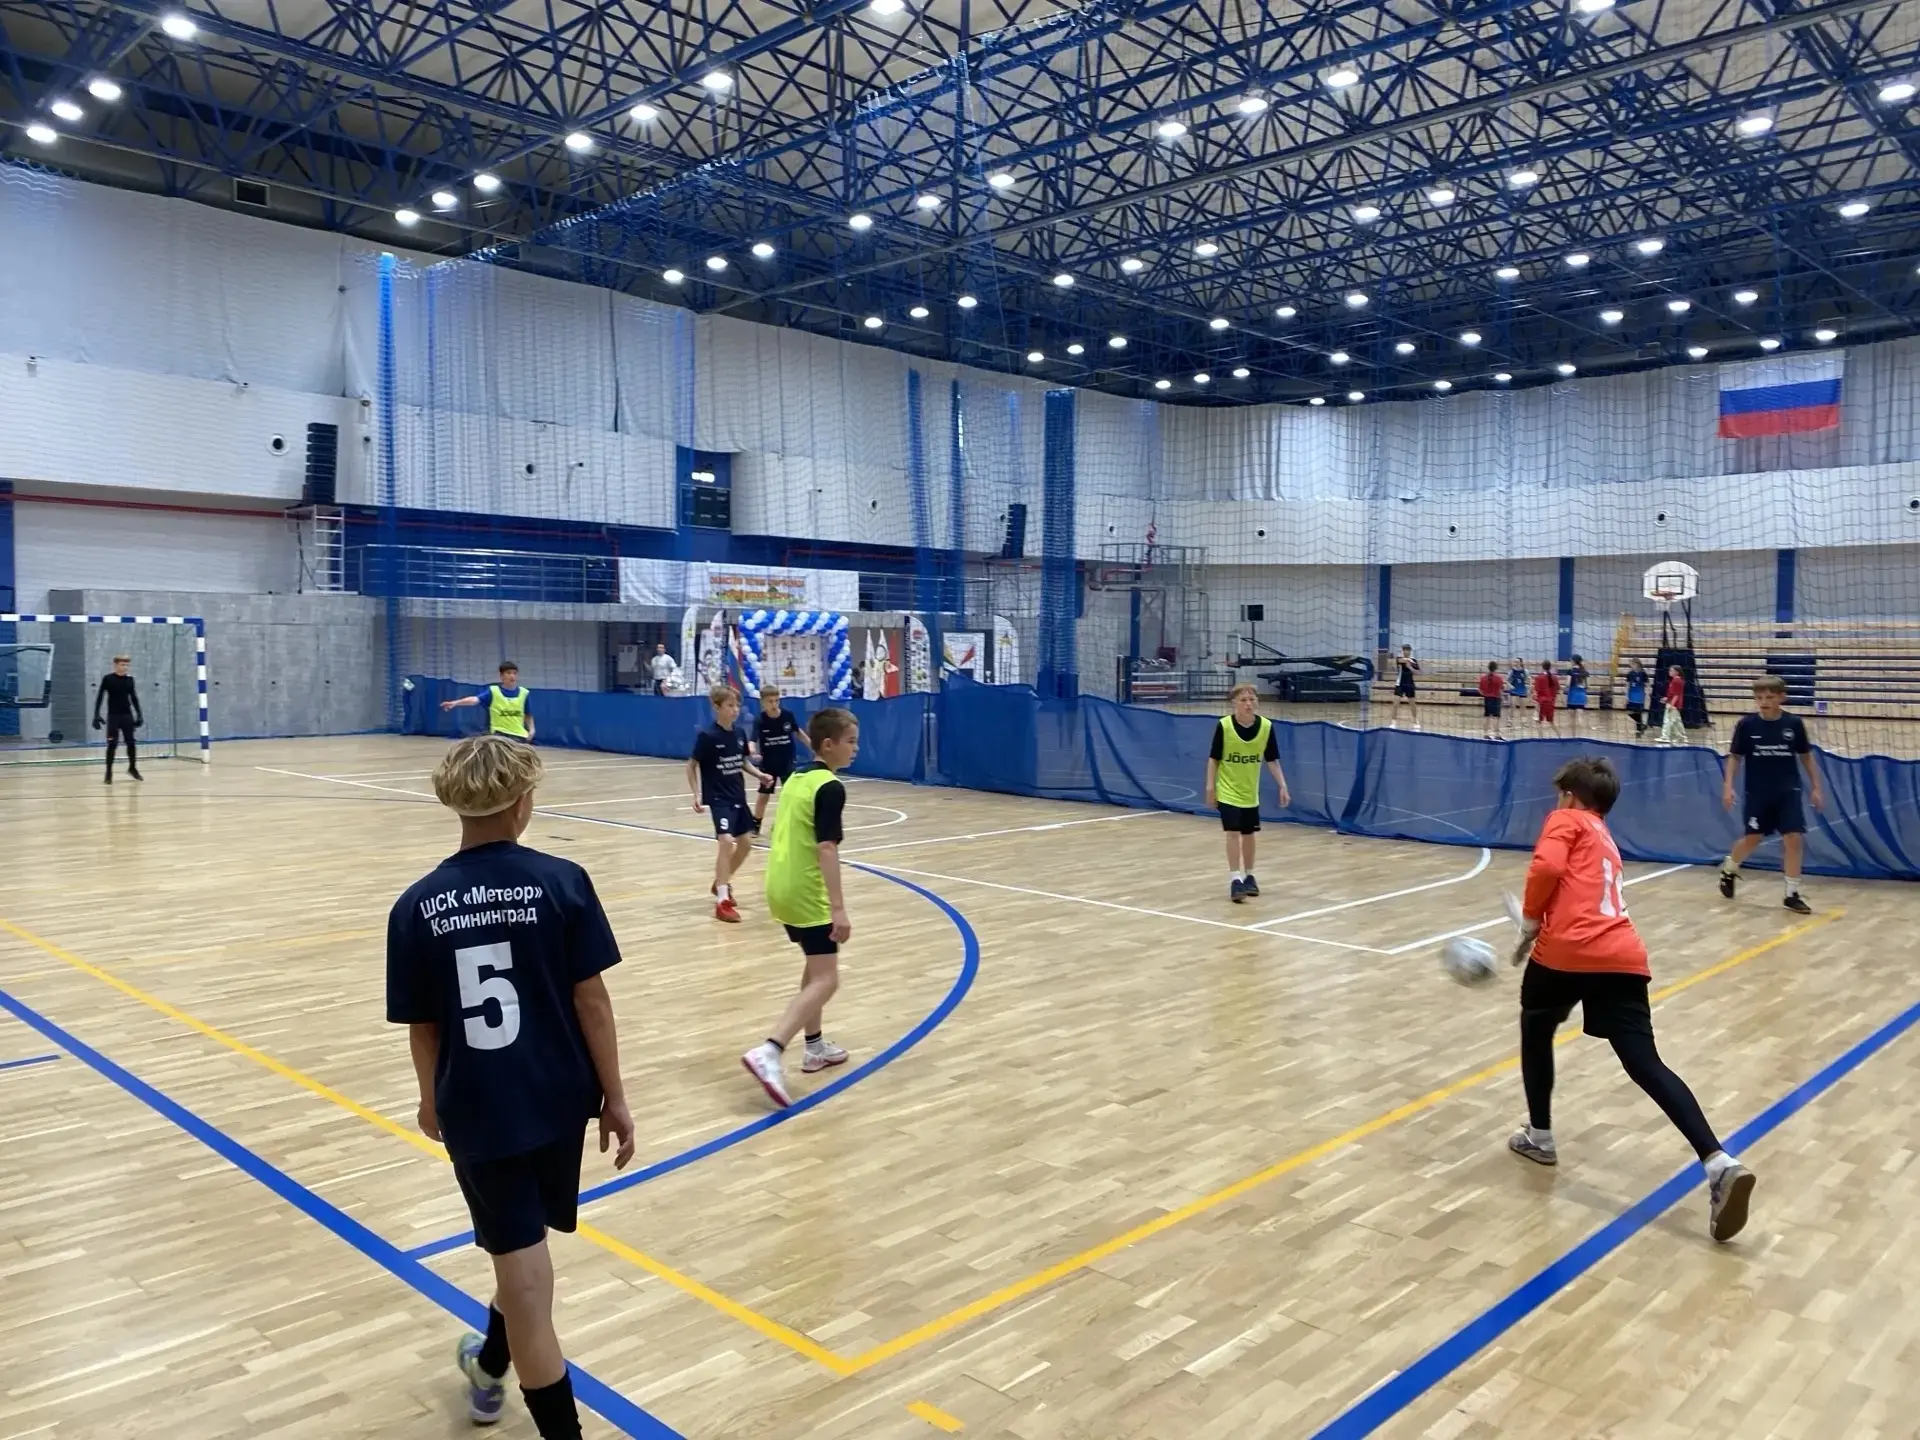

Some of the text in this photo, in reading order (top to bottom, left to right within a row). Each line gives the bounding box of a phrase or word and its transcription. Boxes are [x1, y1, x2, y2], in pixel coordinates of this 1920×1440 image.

[419, 885, 543, 920] ШСК «Метеор»
[430, 907, 538, 937] Калининград
[454, 940, 521, 1051] 5
